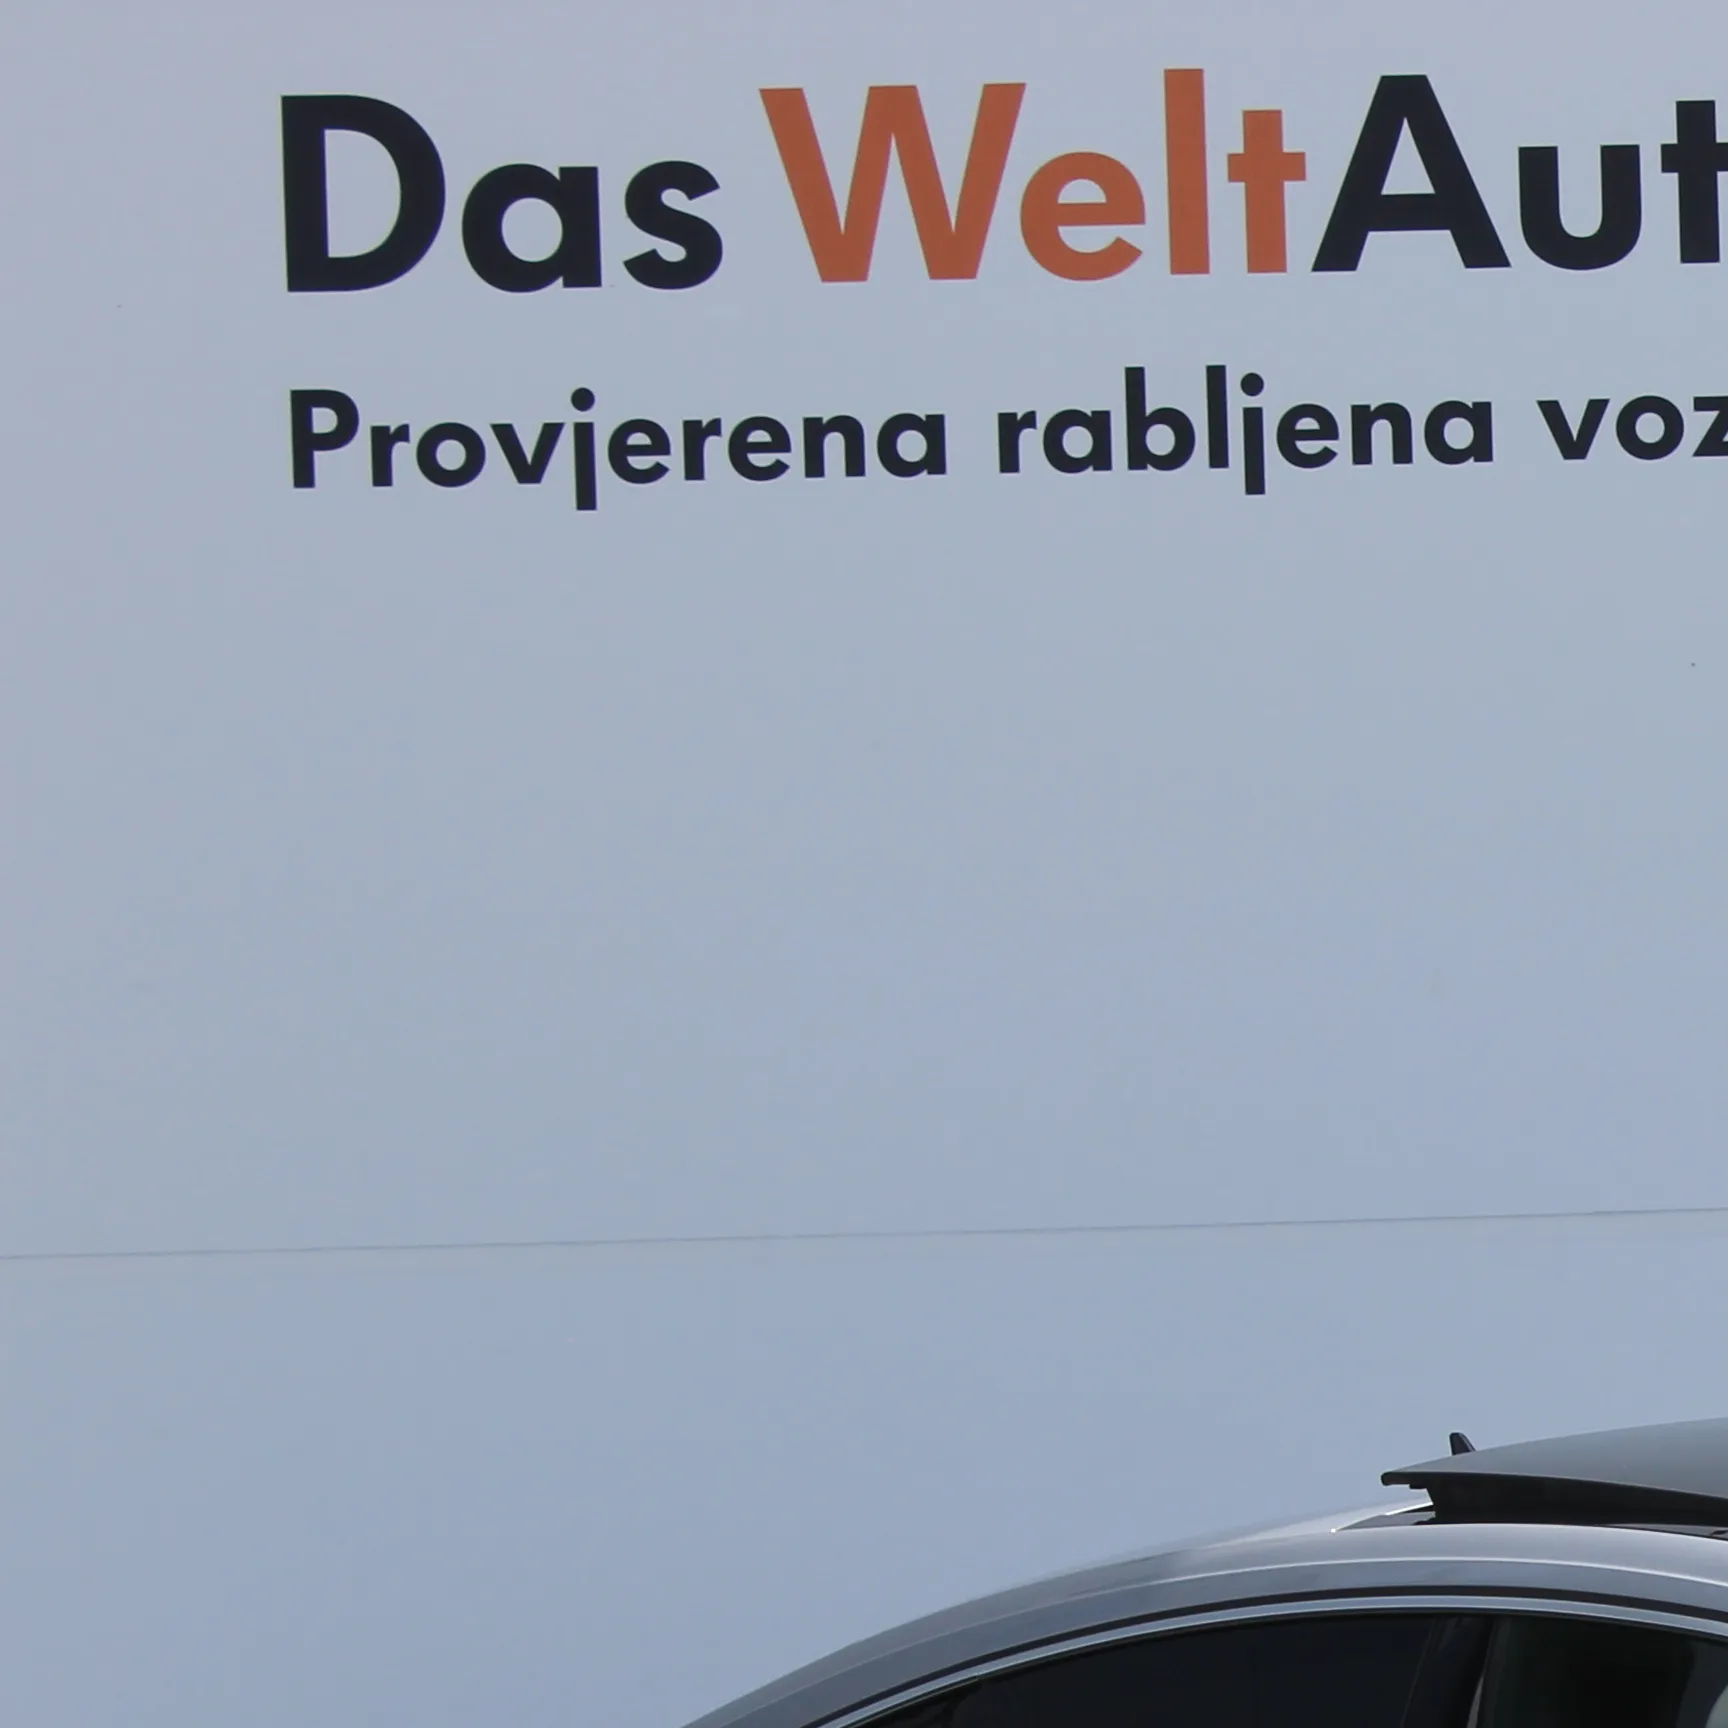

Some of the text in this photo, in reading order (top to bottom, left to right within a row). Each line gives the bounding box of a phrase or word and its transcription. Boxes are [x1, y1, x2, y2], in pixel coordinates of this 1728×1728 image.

[280, 94, 723, 293] Das
[289, 387, 947, 511] Provjerena
[997, 364, 1494, 496] rabljena
